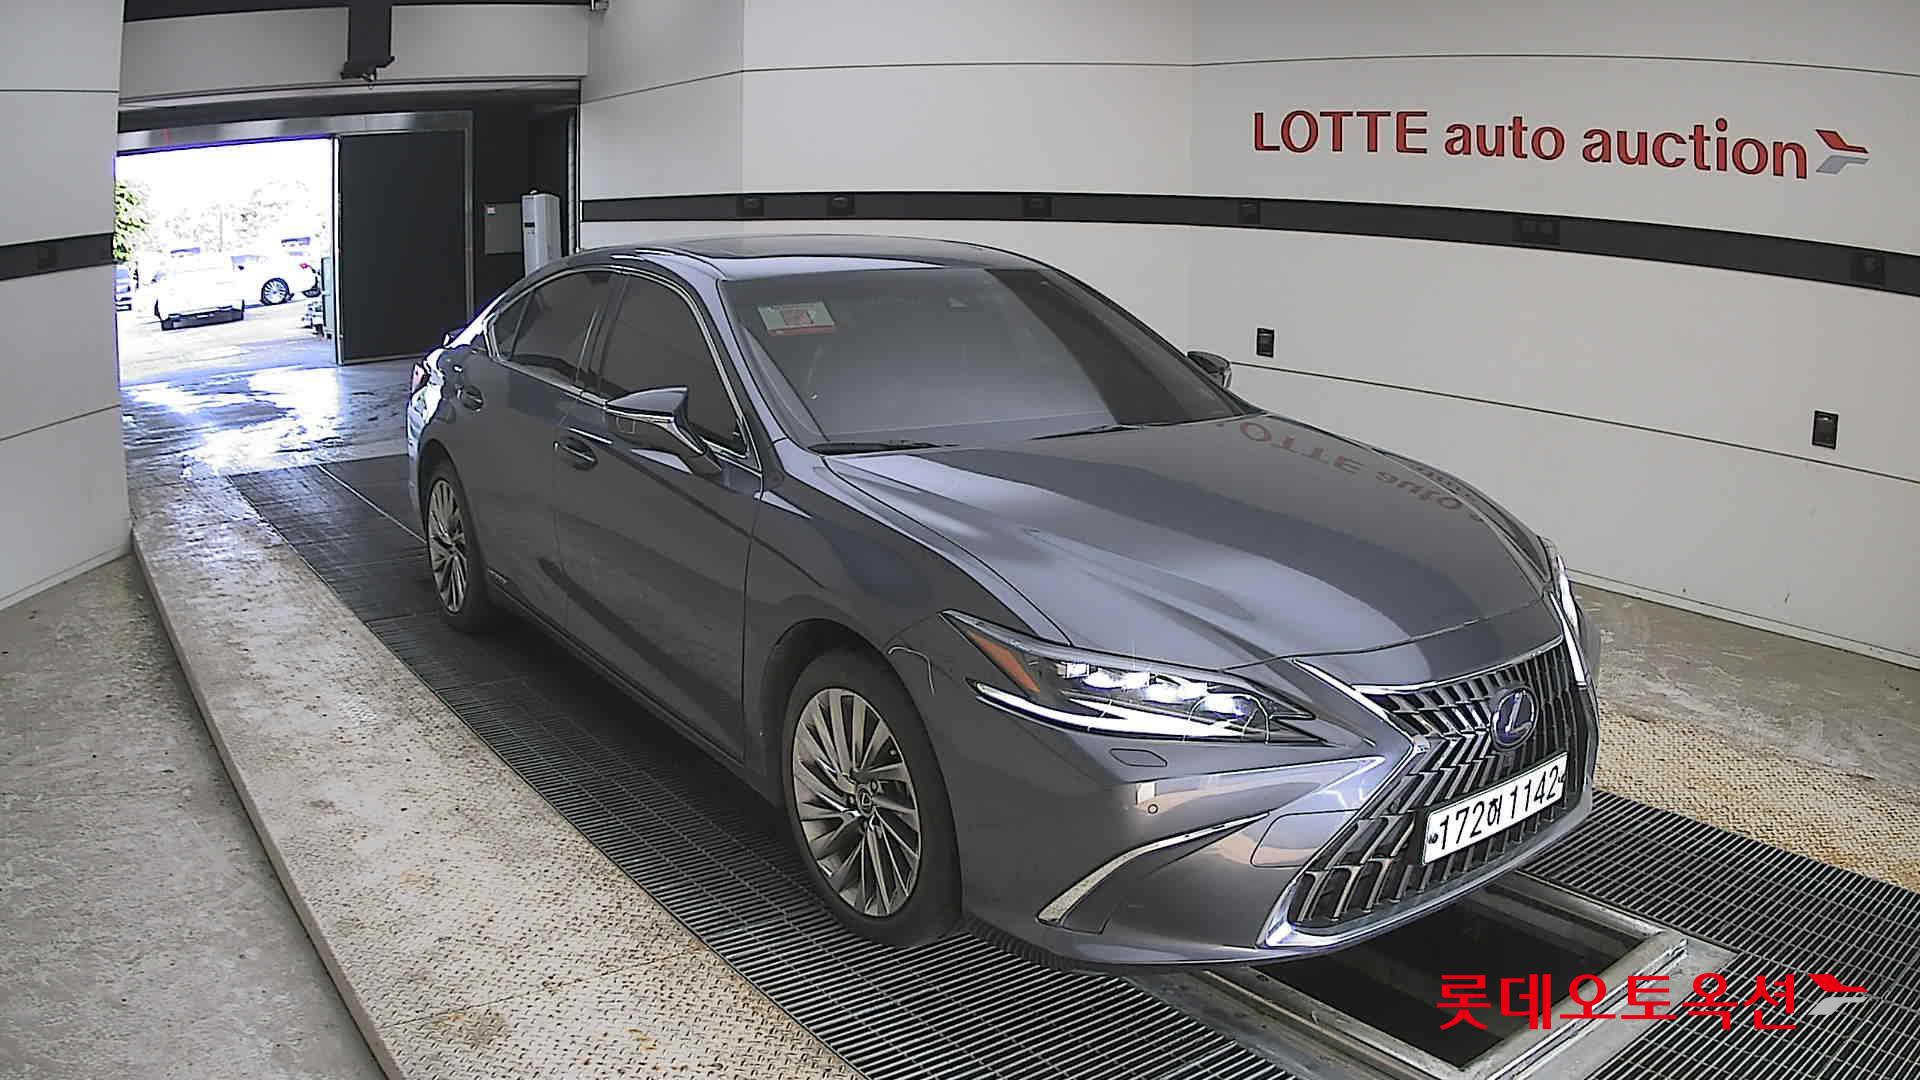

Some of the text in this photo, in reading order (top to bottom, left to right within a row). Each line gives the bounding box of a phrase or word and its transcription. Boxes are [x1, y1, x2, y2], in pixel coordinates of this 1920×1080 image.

[1253, 110, 1808, 180] LOTTE auto auction
